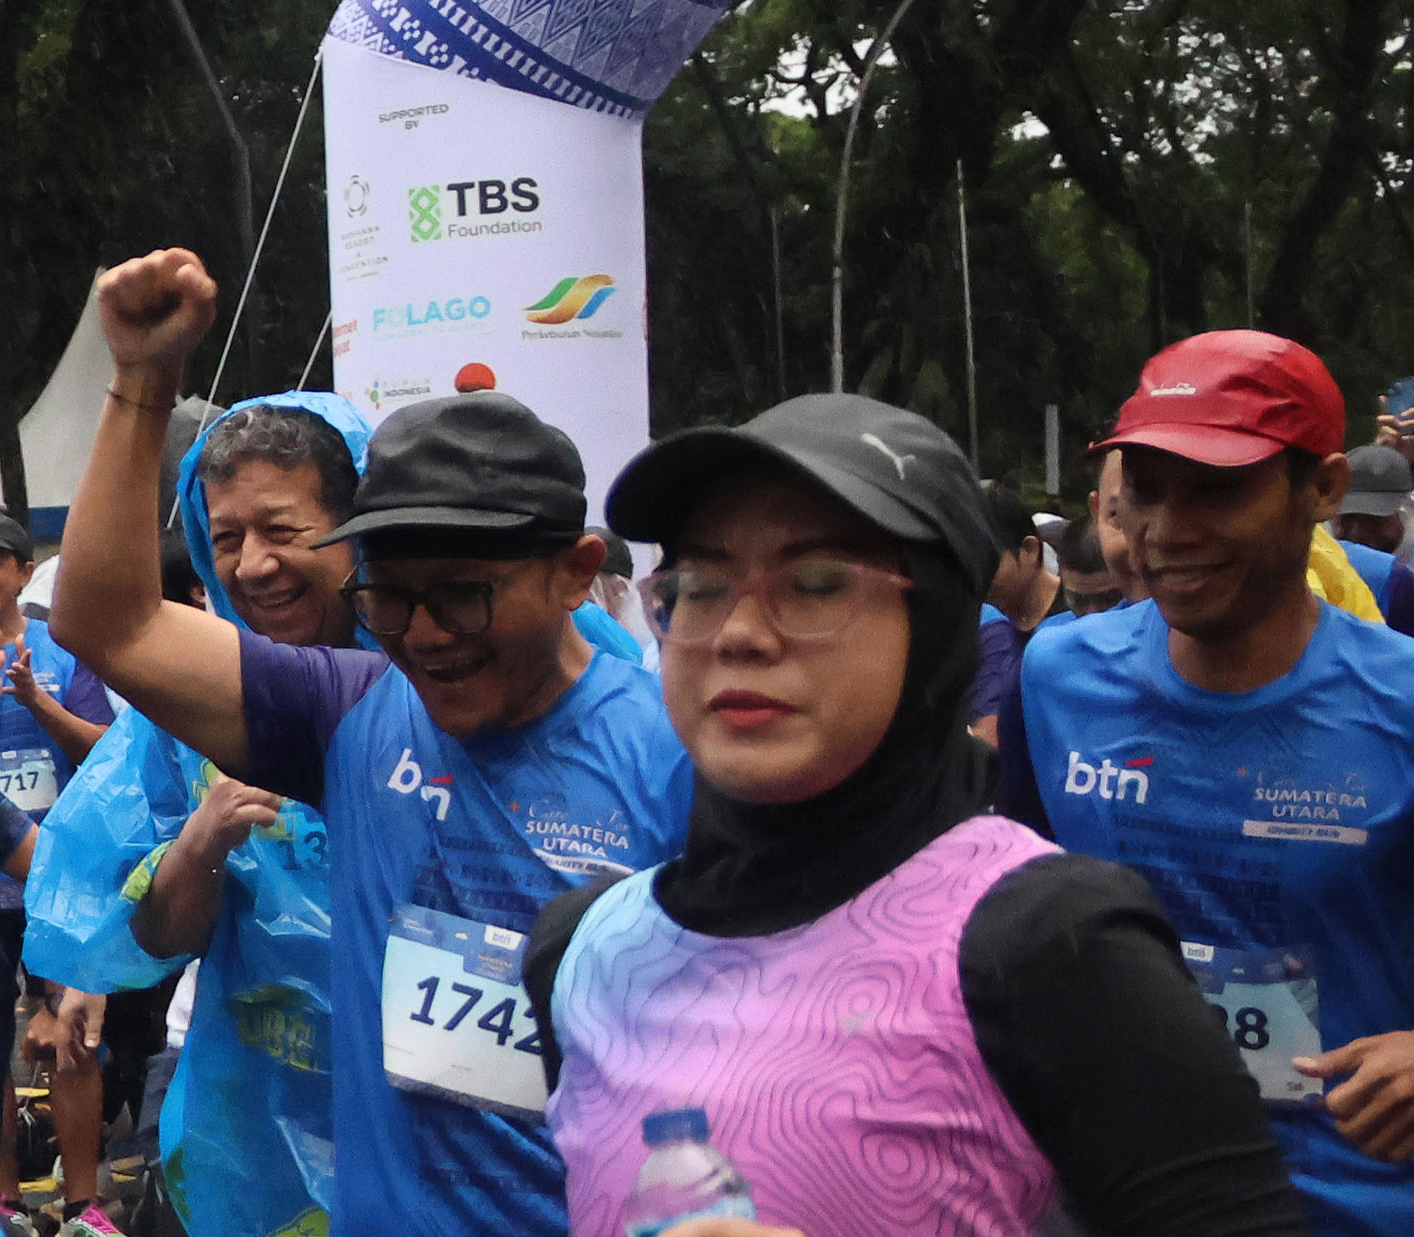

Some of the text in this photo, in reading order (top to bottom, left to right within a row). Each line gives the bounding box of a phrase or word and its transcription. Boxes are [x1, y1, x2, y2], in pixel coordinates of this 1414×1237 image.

[378, 103, 449, 124] SUPPORTED
[447, 177, 540, 218] TBS
[448, 219, 542, 239] Foundation
[373, 296, 492, 331] FOLAGO
[387, 748, 452, 821] bn
[1065, 751, 1150, 804] btn
[1254, 787, 1367, 808] SUMATERA
[1272, 804, 1340, 820] UTARA
[525, 821, 629, 849] SUMATERA
[543, 838, 608, 858] UTARA
[409, 975, 546, 1055] 1742
